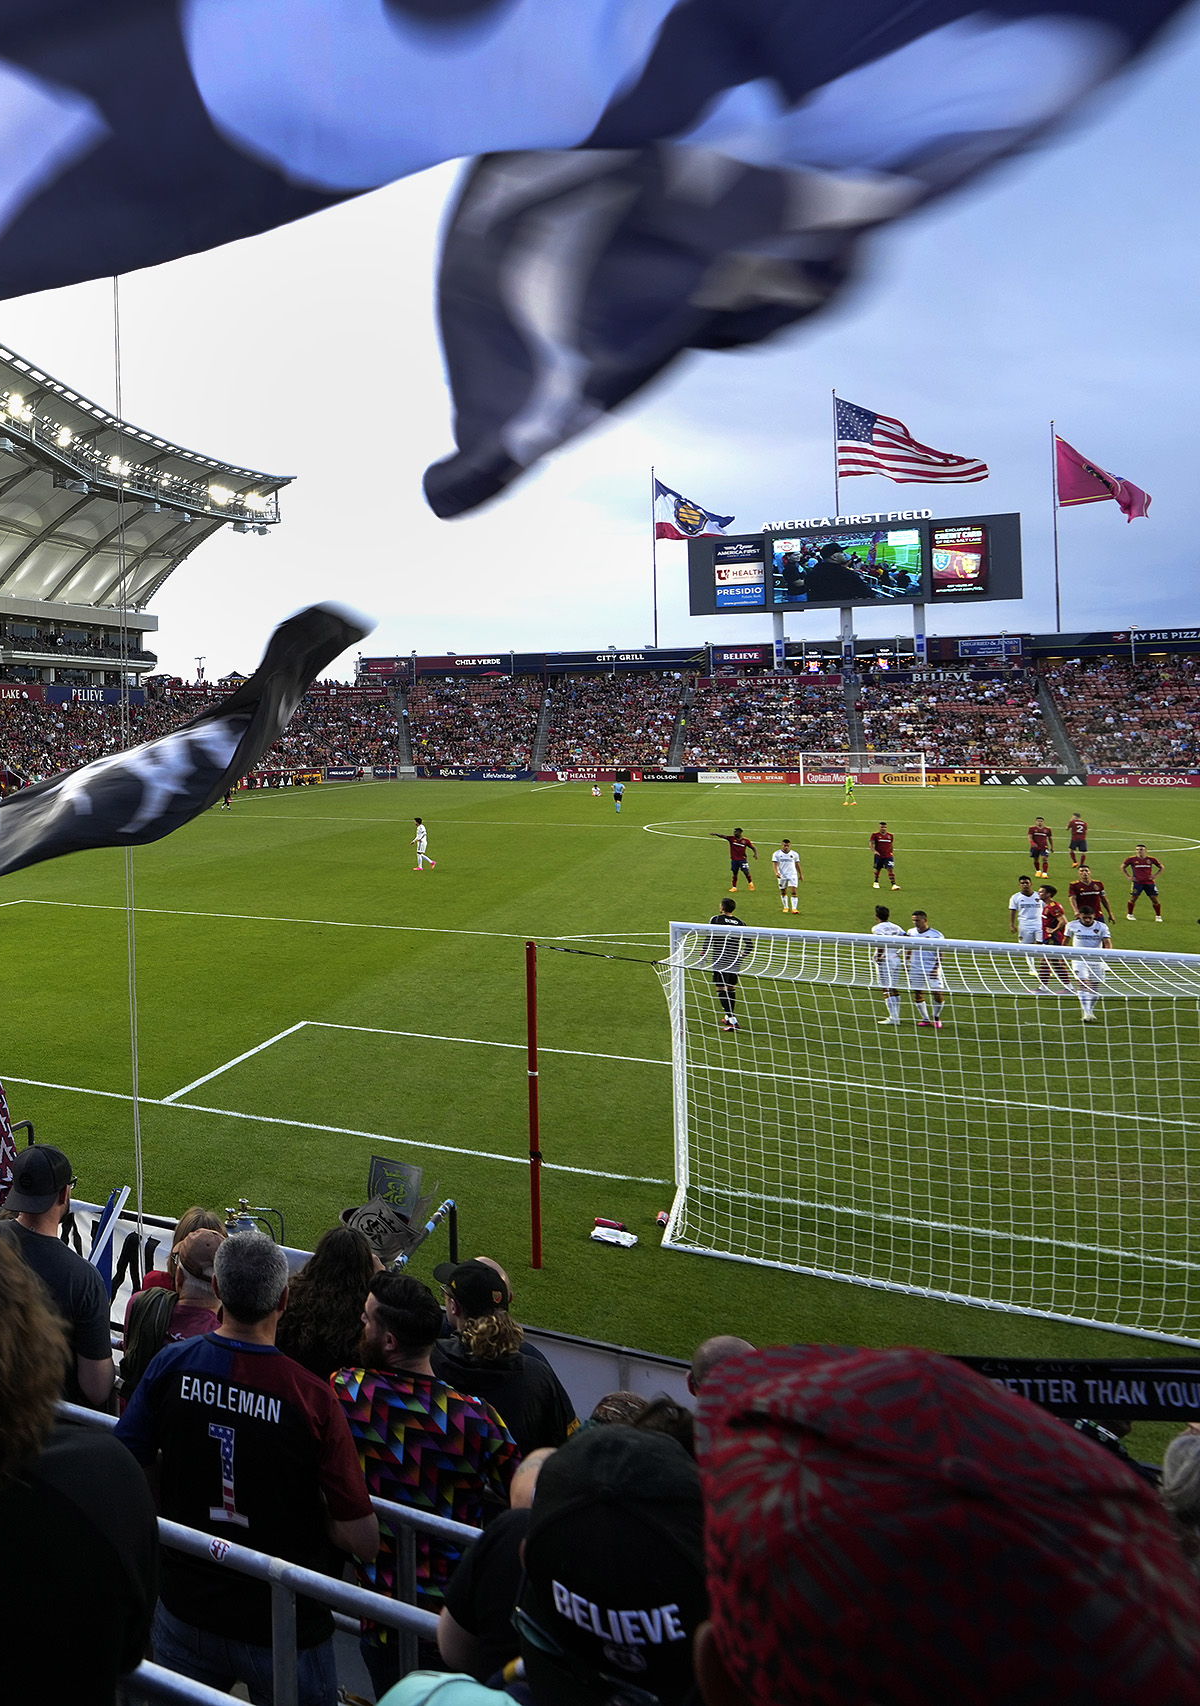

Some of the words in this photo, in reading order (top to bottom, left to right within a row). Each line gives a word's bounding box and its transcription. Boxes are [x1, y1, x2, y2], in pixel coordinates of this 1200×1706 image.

[761, 518, 830, 532] AMERICA
[835, 512, 883, 525] FIRST
[887, 508, 933, 521] FIELD
[935, 532, 961, 540] CREDIT
[717, 587, 762, 595] PRESIDIO
[1149, 632, 1168, 640] PIE
[596, 654, 617, 662] CITY
[619, 653, 644, 661] GRILL
[723, 652, 759, 661] BELIEVE
[455, 658, 474, 666] CHILE
[777, 677, 799, 685] LAKE
[912, 672, 971, 682] BELIEVE
[1, 689, 20, 699] LAKE
[482, 772, 517, 780] LifeVantage
[807, 773, 831, 783] Captain
[1098, 776, 1129, 784] Audi
[1076, 824, 1084, 833] 2
[1084, 1380, 1148, 1406] THAN
[1153, 1381, 1200, 1408] YOU
[180, 1375, 281, 1424] EAGLEMAN
[208, 1422, 249, 1529] 1
[552, 1579, 687, 1646] BELIEVE
